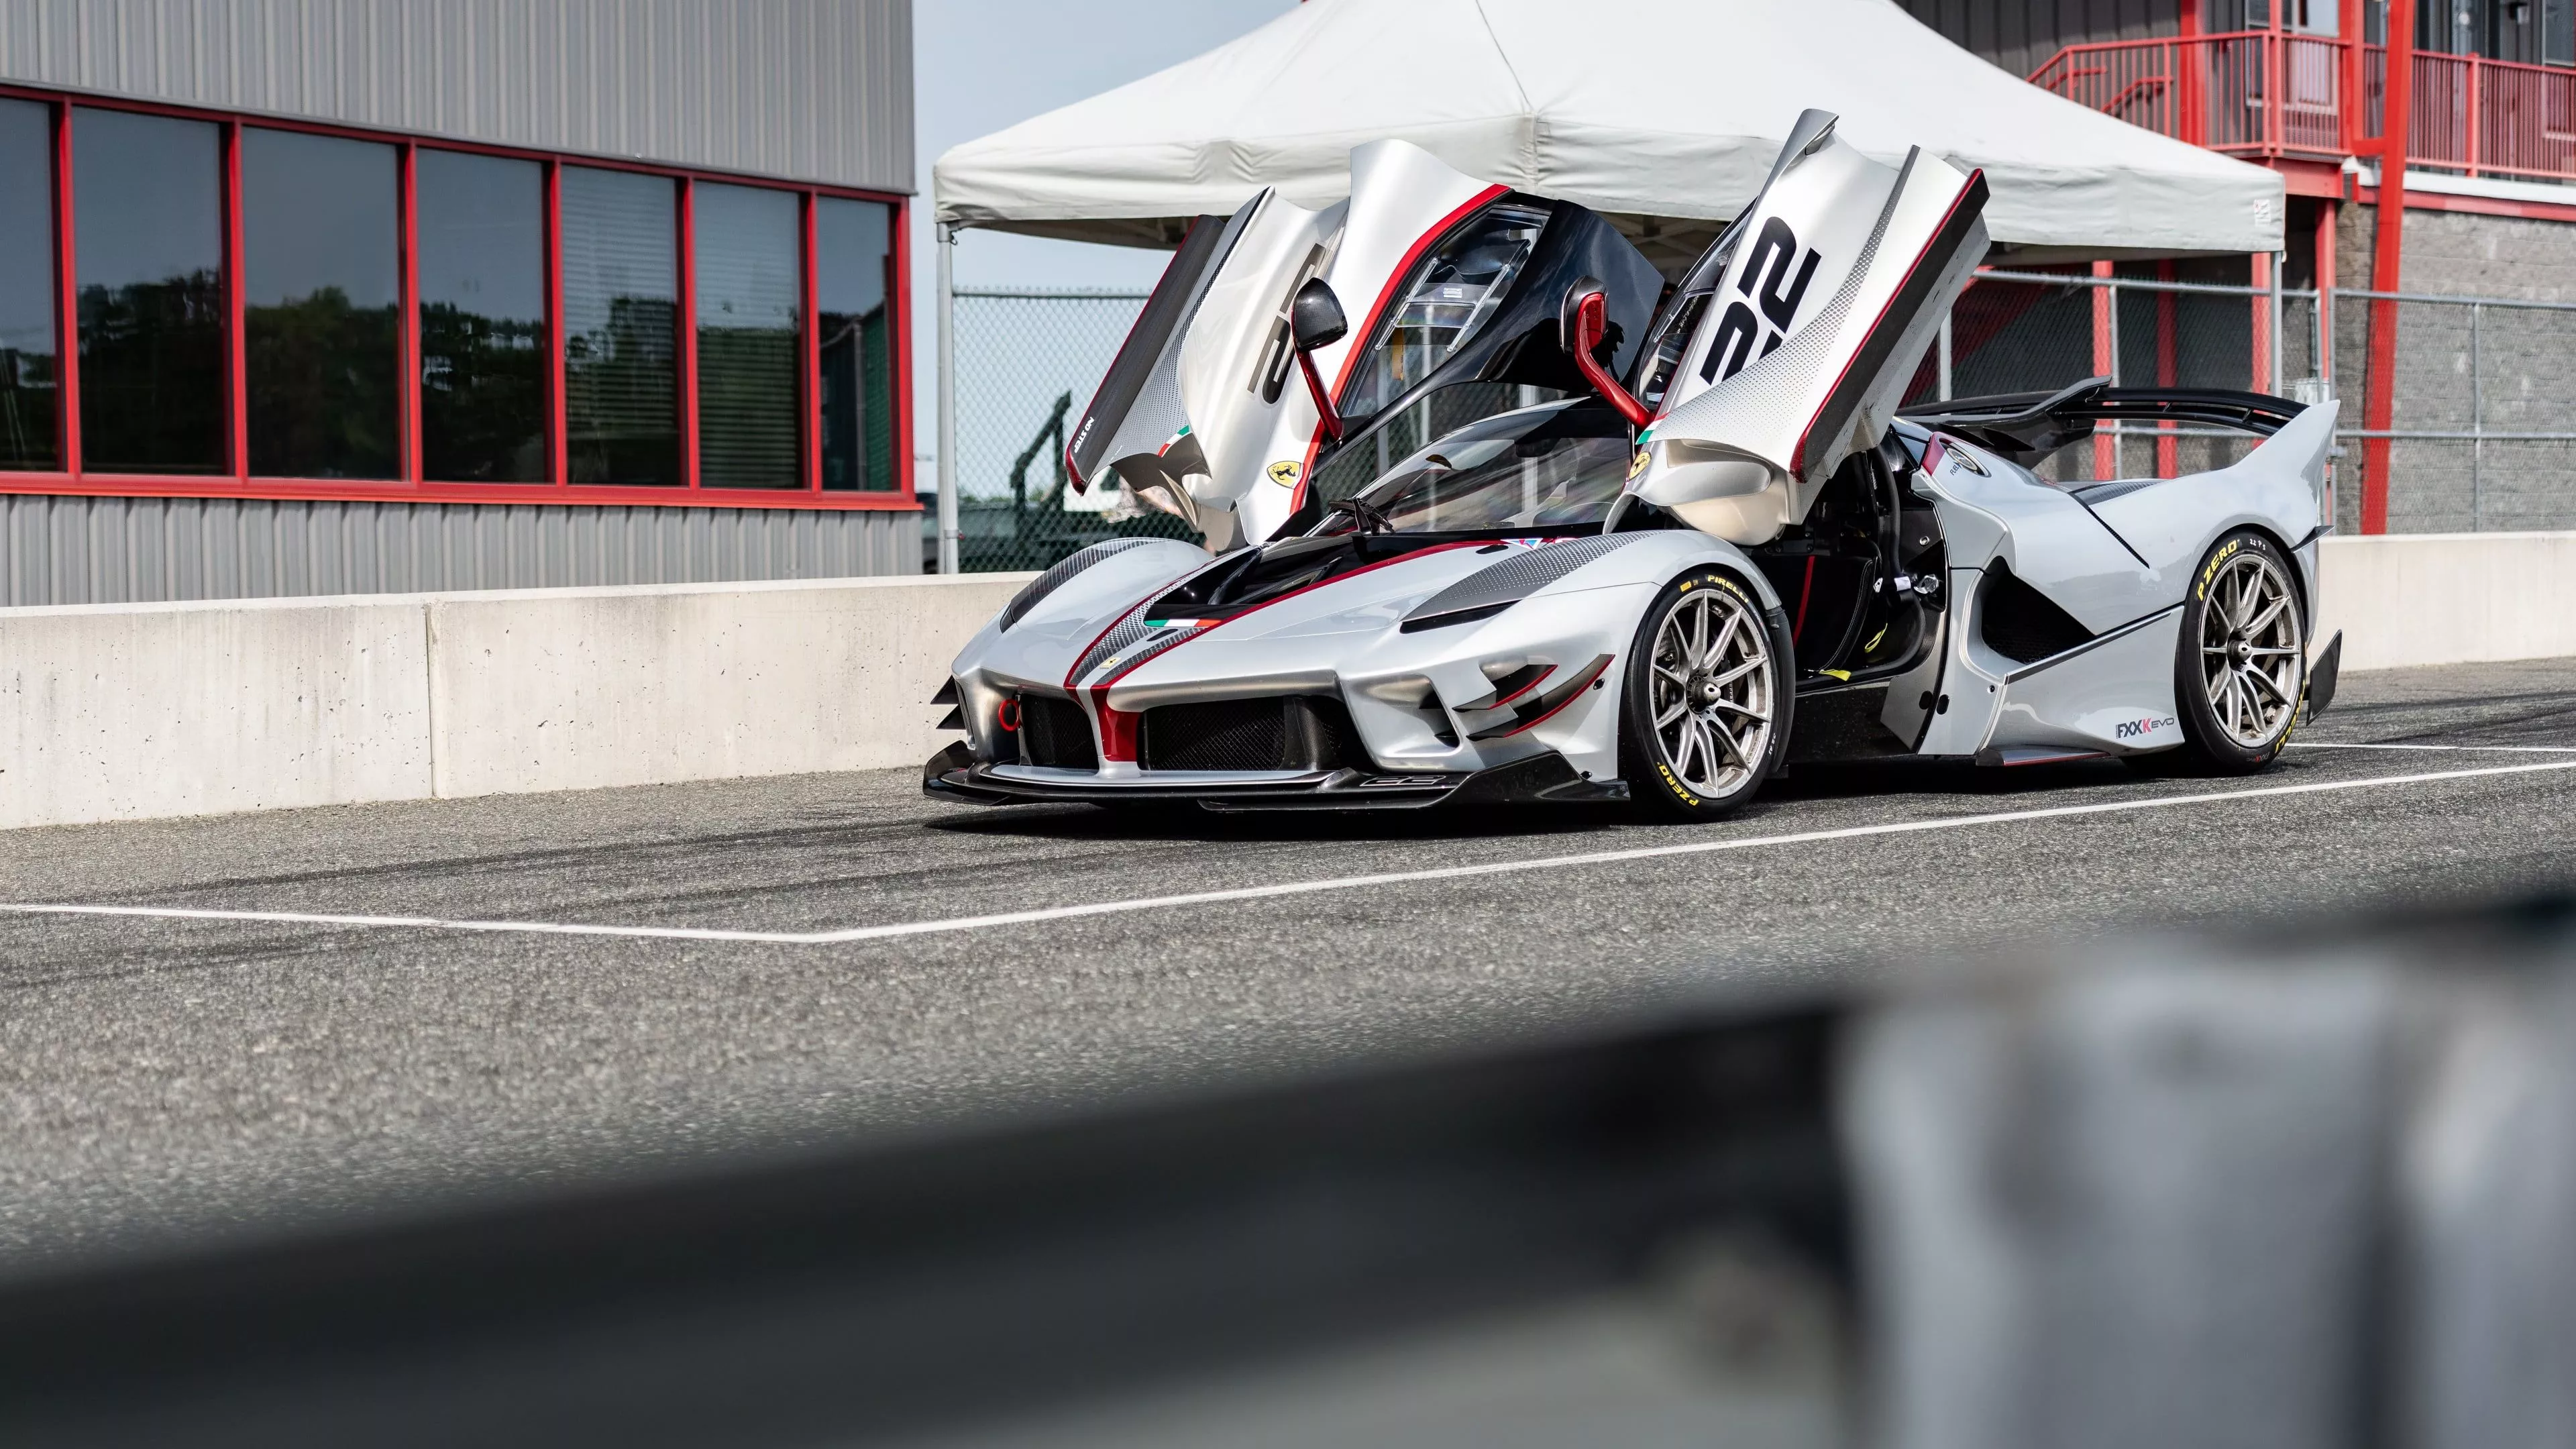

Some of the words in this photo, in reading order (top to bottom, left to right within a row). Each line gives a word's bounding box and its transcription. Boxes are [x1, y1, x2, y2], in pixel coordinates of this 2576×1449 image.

[1085, 417, 1095, 431] NO
[1074, 429, 1087, 453] STEP
[2204, 540, 2237, 585] ZERO
[1707, 575, 1749, 603] PIRELLI
